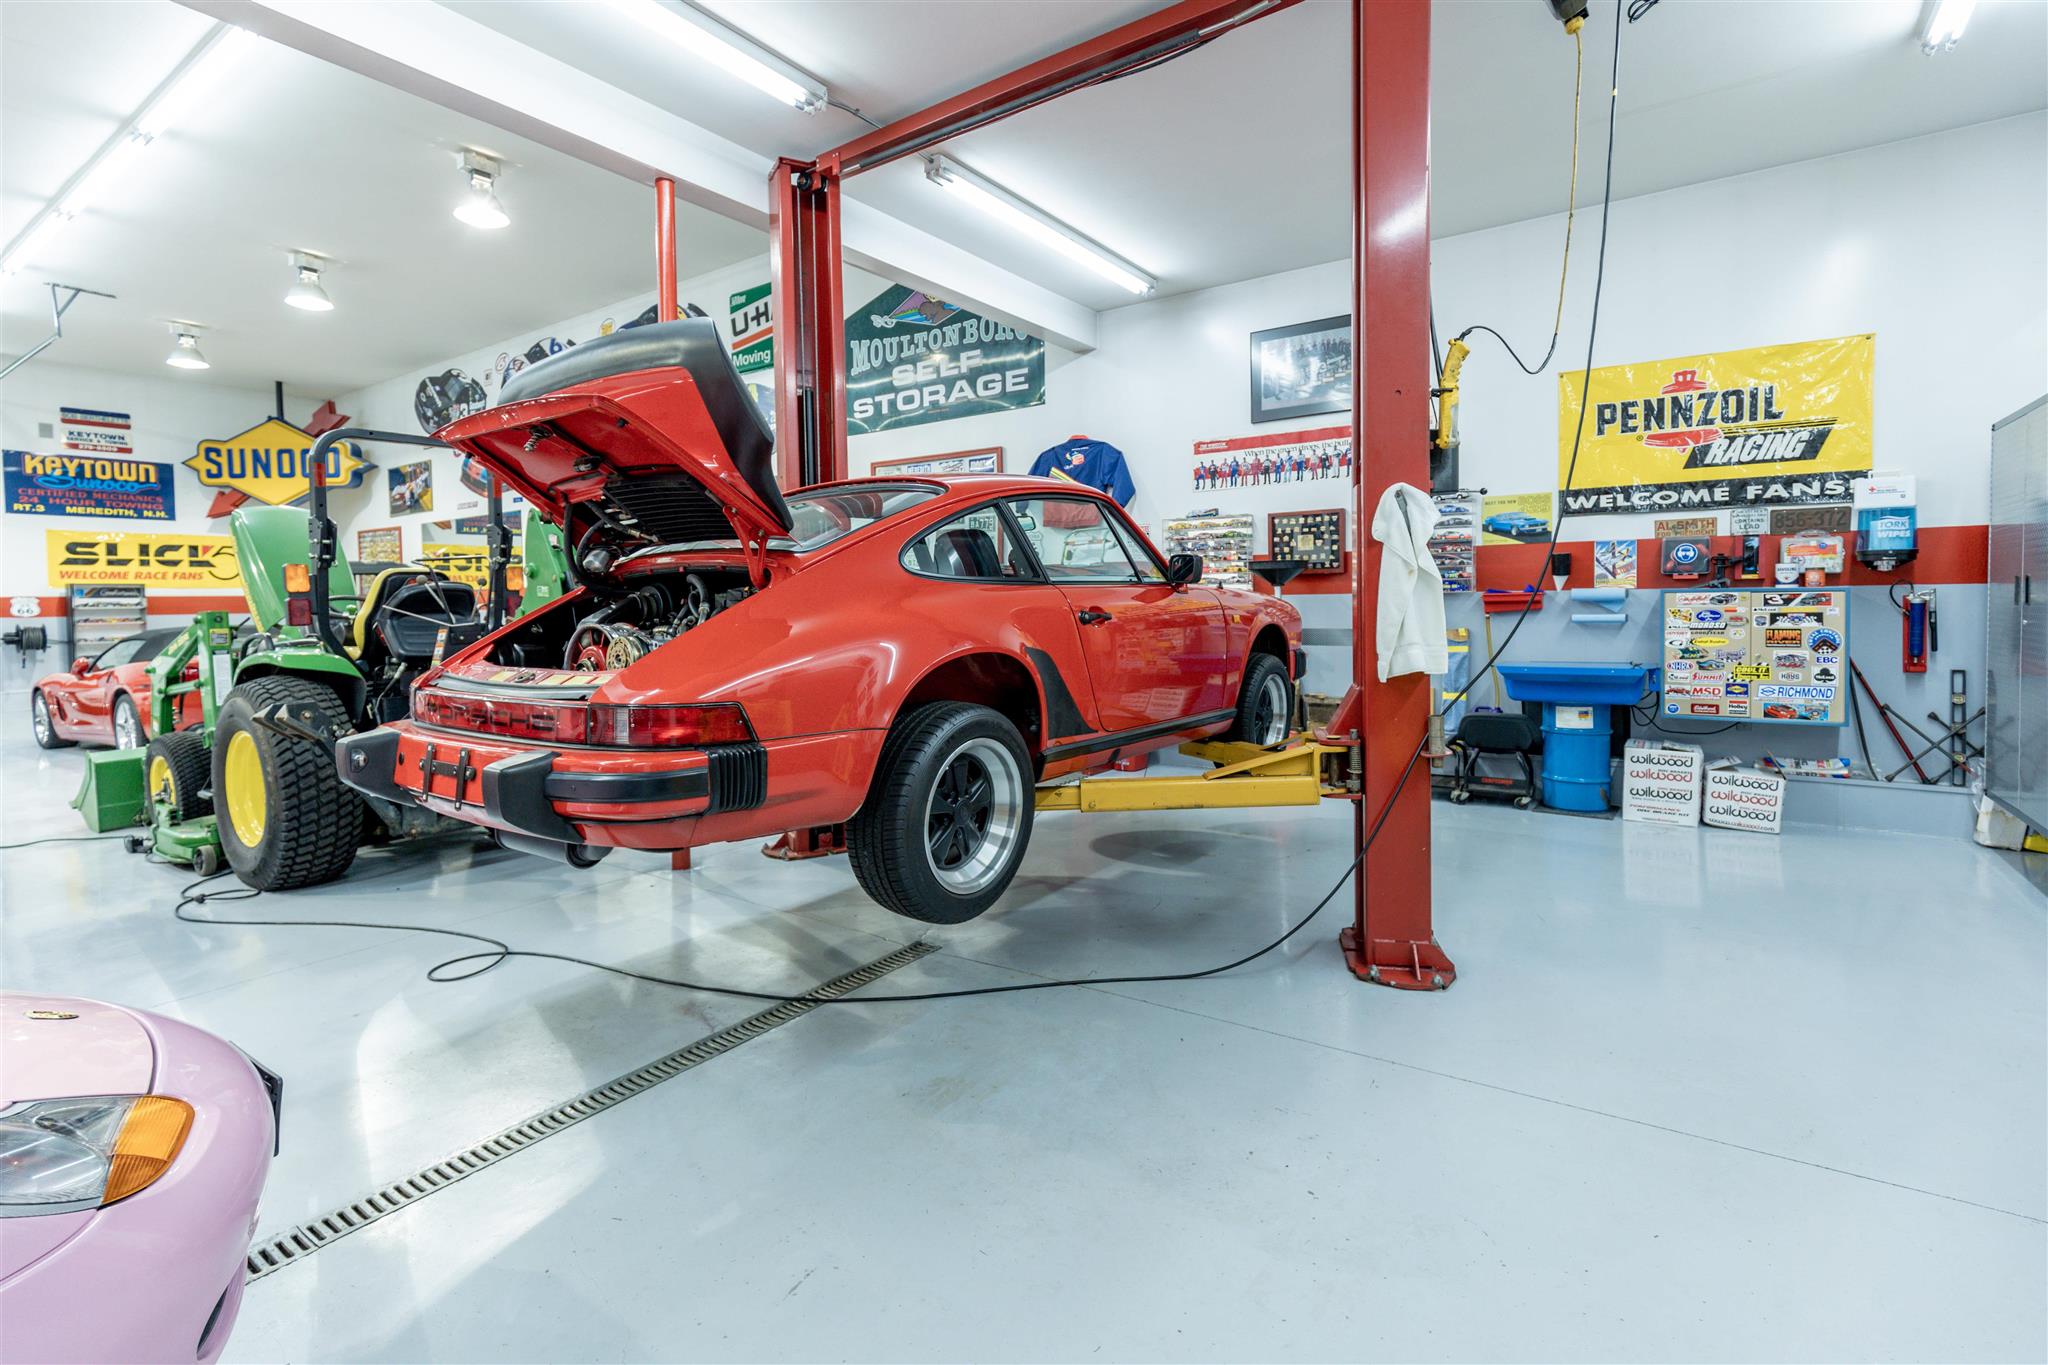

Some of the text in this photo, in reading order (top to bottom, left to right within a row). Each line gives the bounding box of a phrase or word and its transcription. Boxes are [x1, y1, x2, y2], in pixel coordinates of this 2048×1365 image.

[732, 349, 771, 368] Moving
[892, 349, 983, 387] SELF
[853, 368, 1029, 419] STORAGE
[1596, 385, 1785, 436] PENNZOIL
[68, 430, 125, 441] KEYTOWN
[1704, 429, 1813, 465] RACING
[34, 470, 159, 492] Sunoco
[18, 488, 163, 503] CERTIFIED MECHANICS
[1567, 487, 1730, 509] WELCOME
[13, 503, 169, 518] RT.3 MEREDITH, N.H.
[49, 497, 96, 507] HOUR
[104, 500, 164, 510] TOWING
[1877, 529, 1911, 538] WIPES
[59, 541, 216, 567] SLICK
[59, 570, 204, 581] WELCOME RACE FANS
[1764, 594, 1784, 605] 3
[1766, 629, 1801, 638] FLAMING
[1692, 687, 1721, 695] MSD
[1777, 687, 1833, 698] RICHMOND
[1630, 754, 1693, 767] wilwood
[1630, 768, 1693, 783] wilwood
[1712, 775, 1779, 791] wilwood
[1629, 786, 1693, 801] wilwood
[1711, 790, 1778, 807] wilwood
[1709, 805, 1777, 822] wilwood
